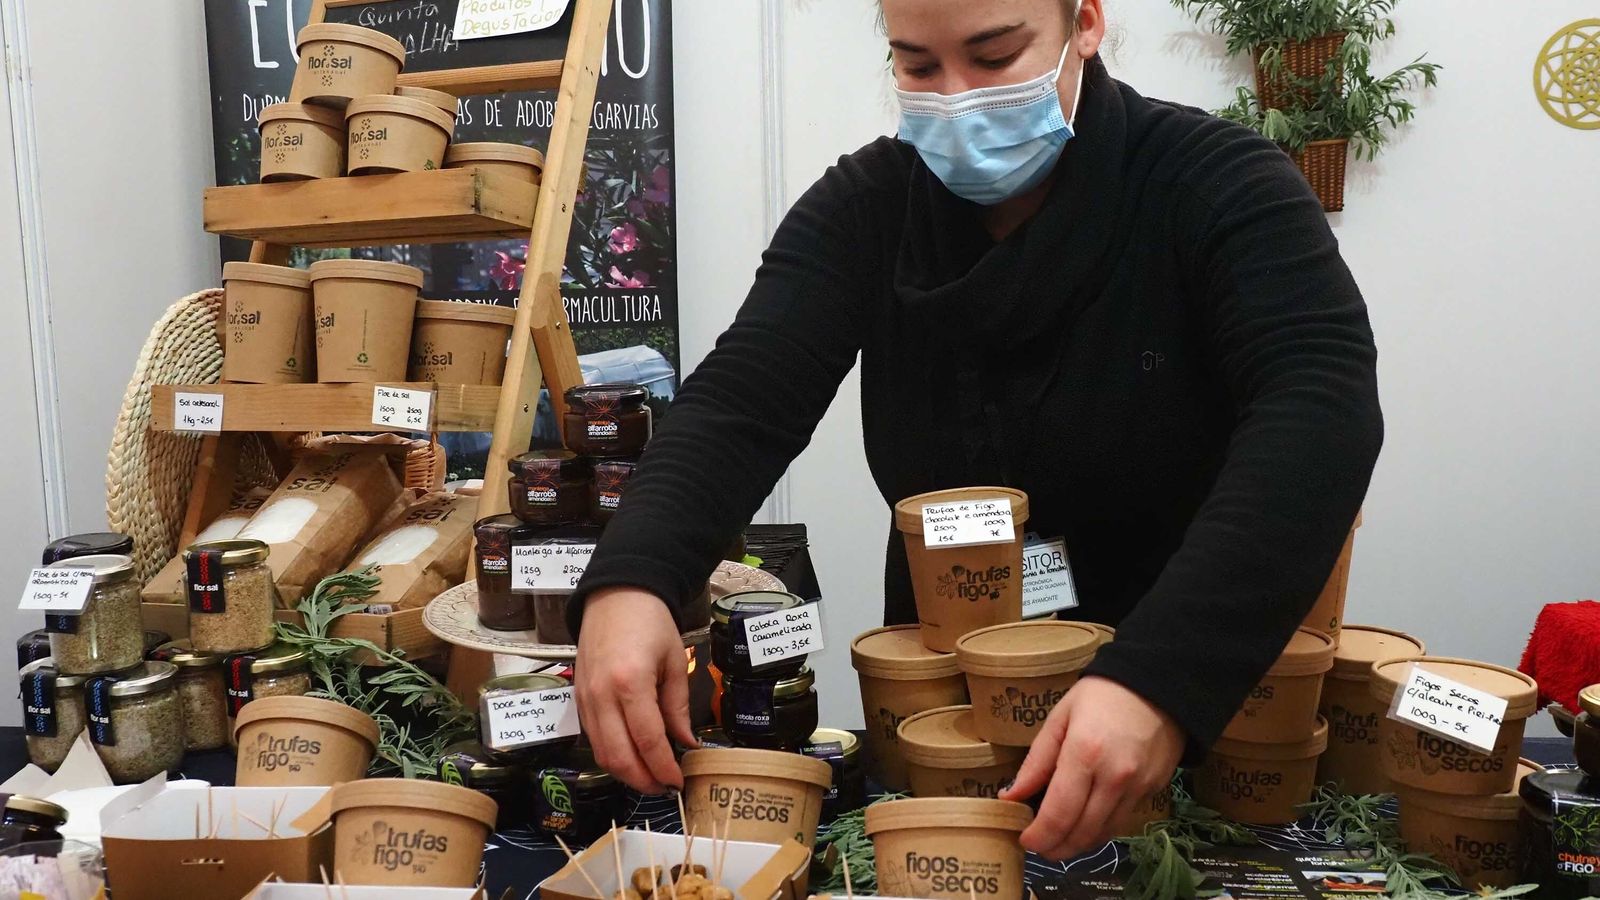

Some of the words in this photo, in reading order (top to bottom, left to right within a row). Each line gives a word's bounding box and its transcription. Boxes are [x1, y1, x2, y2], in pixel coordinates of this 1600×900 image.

[485, 99, 502, 127] DE
[516, 99, 558, 127] ADOB
[588, 101, 658, 130] GARVIAS
[966, 566, 1011, 585] trufas
[957, 582, 989, 602] figo
[492, 700, 515, 711] Doce
[520, 697, 531, 705] de
[1021, 688, 1071, 707] trufa
[504, 707, 545, 720] Amarga
[1411, 707, 1437, 725] 100g
[1455, 723, 1470, 734] 5€
[499, 729, 526, 741] 130g
[536, 724, 557, 736] 3,5€
[268, 735, 321, 755] trufas
[256, 750, 289, 772] figo
[1441, 756, 1504, 773] secos
[731, 804, 789, 824] secos
[387, 827, 448, 852] trufas
[373, 844, 413, 871] figo
[906, 852, 959, 879] figos
[932, 876, 998, 894] secos
